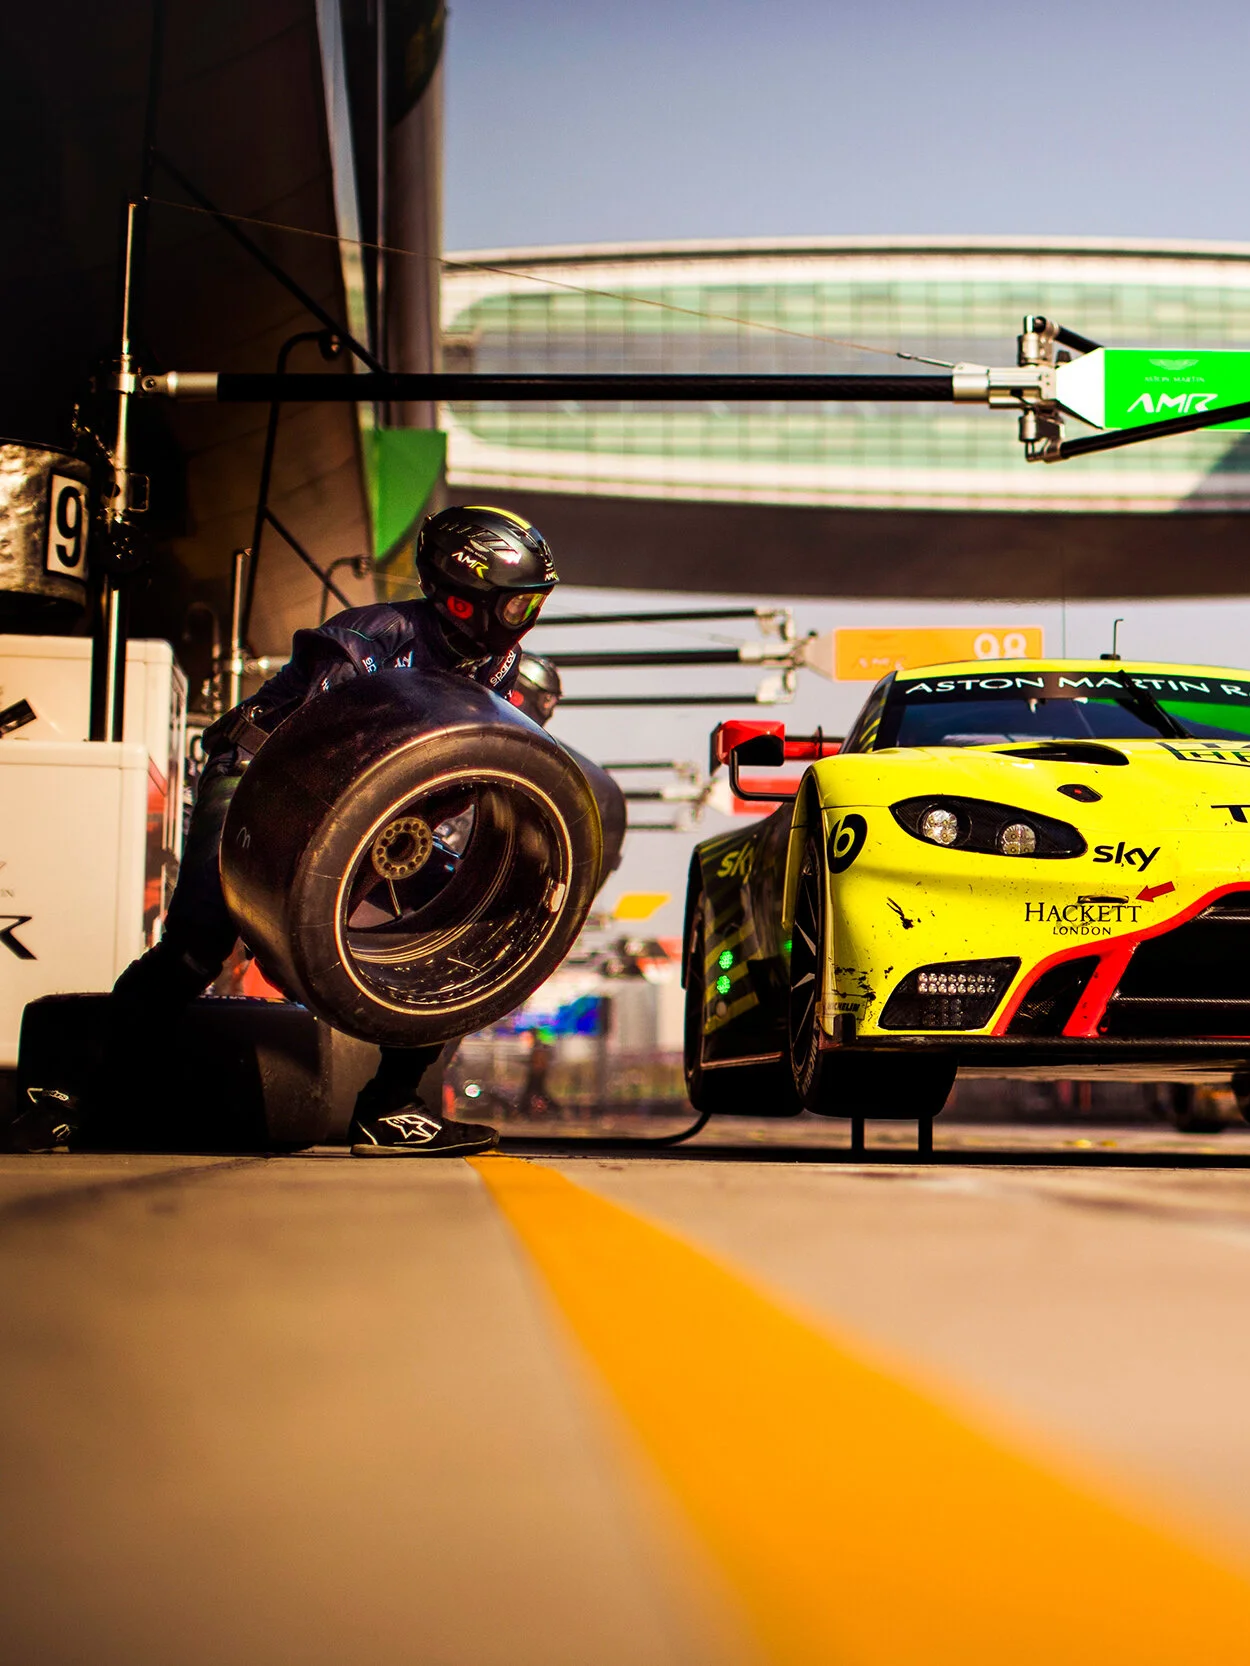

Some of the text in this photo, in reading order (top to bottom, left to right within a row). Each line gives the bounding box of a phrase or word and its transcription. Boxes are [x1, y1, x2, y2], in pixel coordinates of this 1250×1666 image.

[1127, 393, 1218, 413] AMR
[56, 485, 82, 568] 9
[451, 551, 489, 579] AMR
[973, 633, 1027, 660] 98
[489, 650, 516, 687] sparco
[905, 676, 1045, 695] ASTON
[1058, 676, 1211, 693] MARTIN
[1092, 842, 1161, 872] sky
[1025, 902, 1142, 923] HACKETT
[1053, 926, 1111, 935] LONDON
